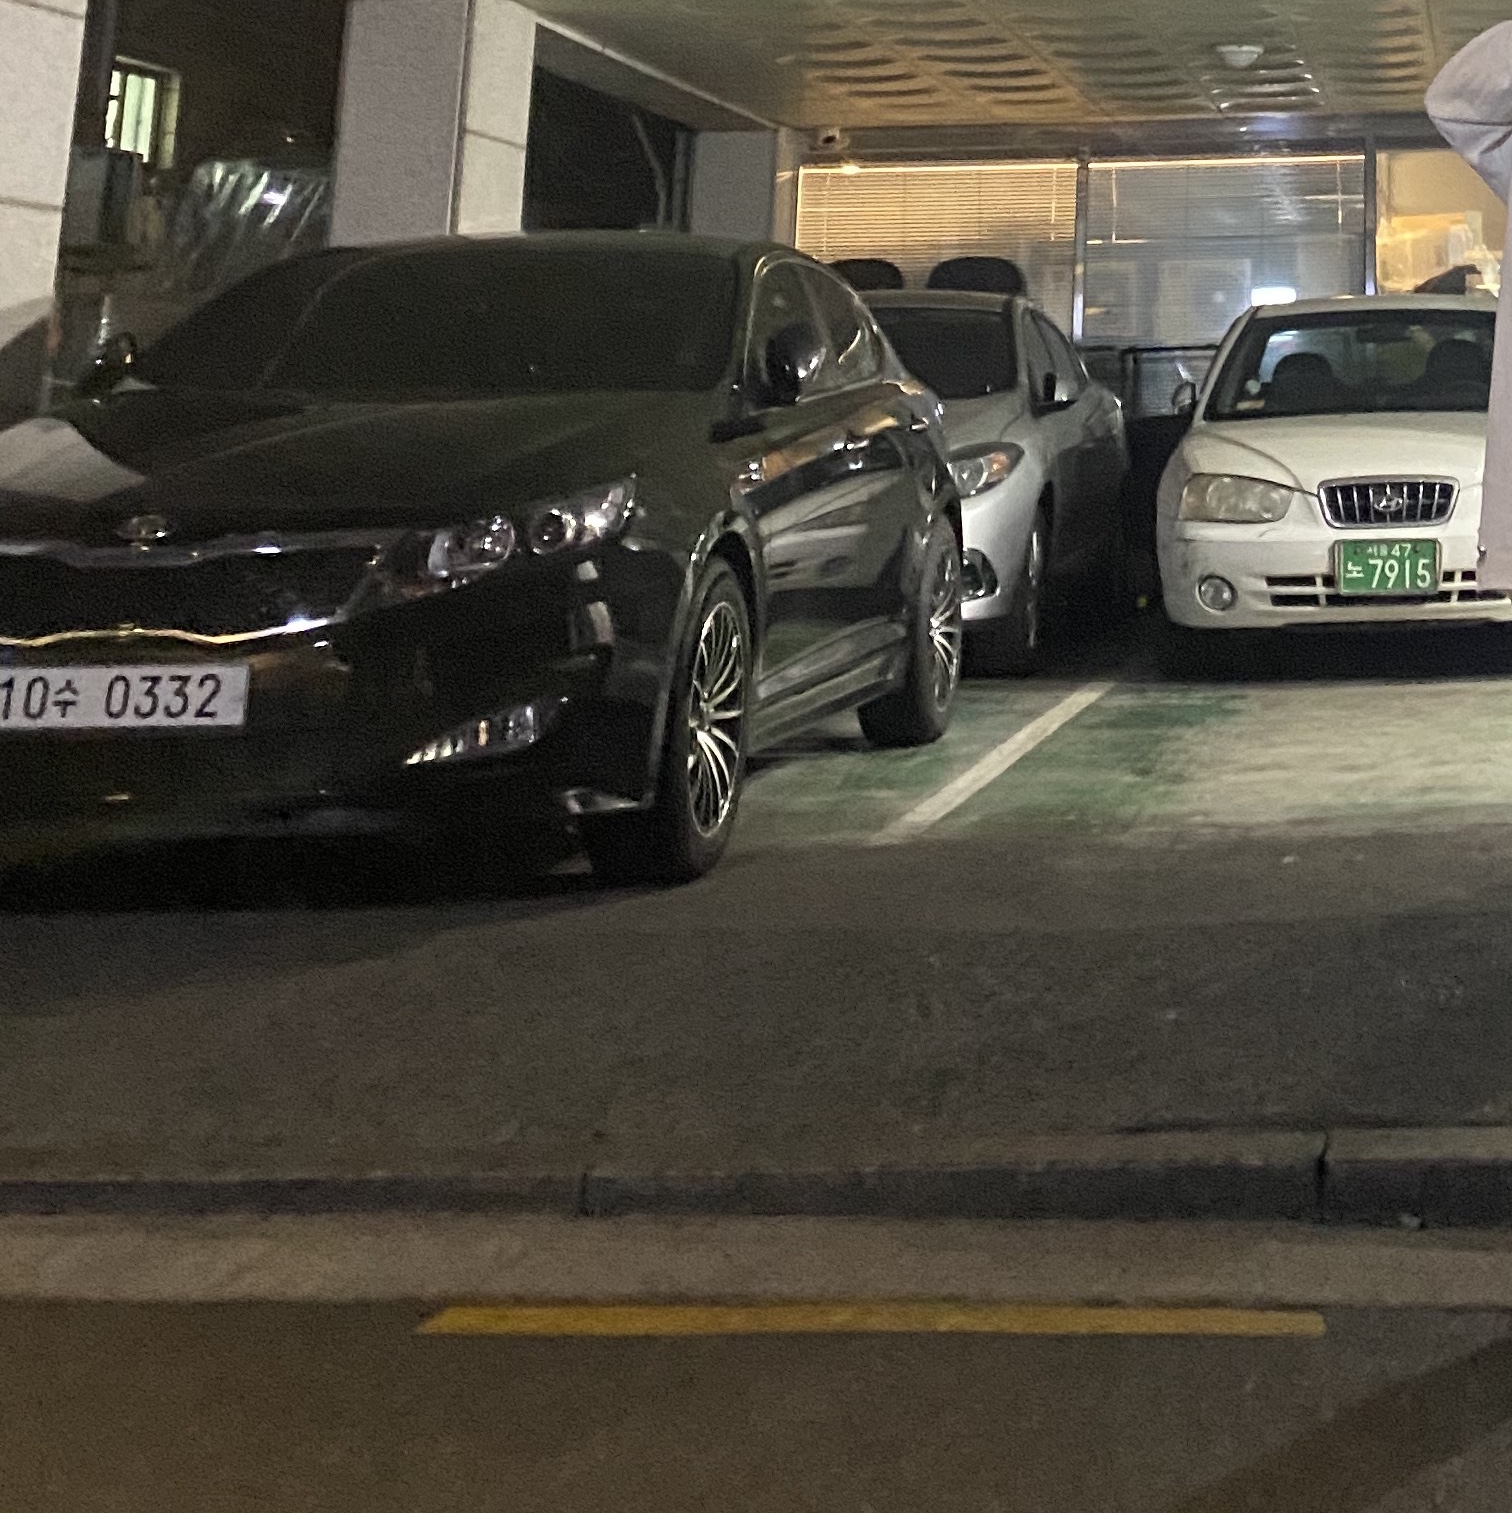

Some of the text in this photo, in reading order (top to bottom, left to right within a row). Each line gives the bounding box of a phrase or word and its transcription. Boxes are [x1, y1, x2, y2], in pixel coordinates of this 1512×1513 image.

[1391, 543, 1412, 558] 47
[1368, 557, 1432, 589] 7915
[0, 673, 222, 721] 10수 0332
